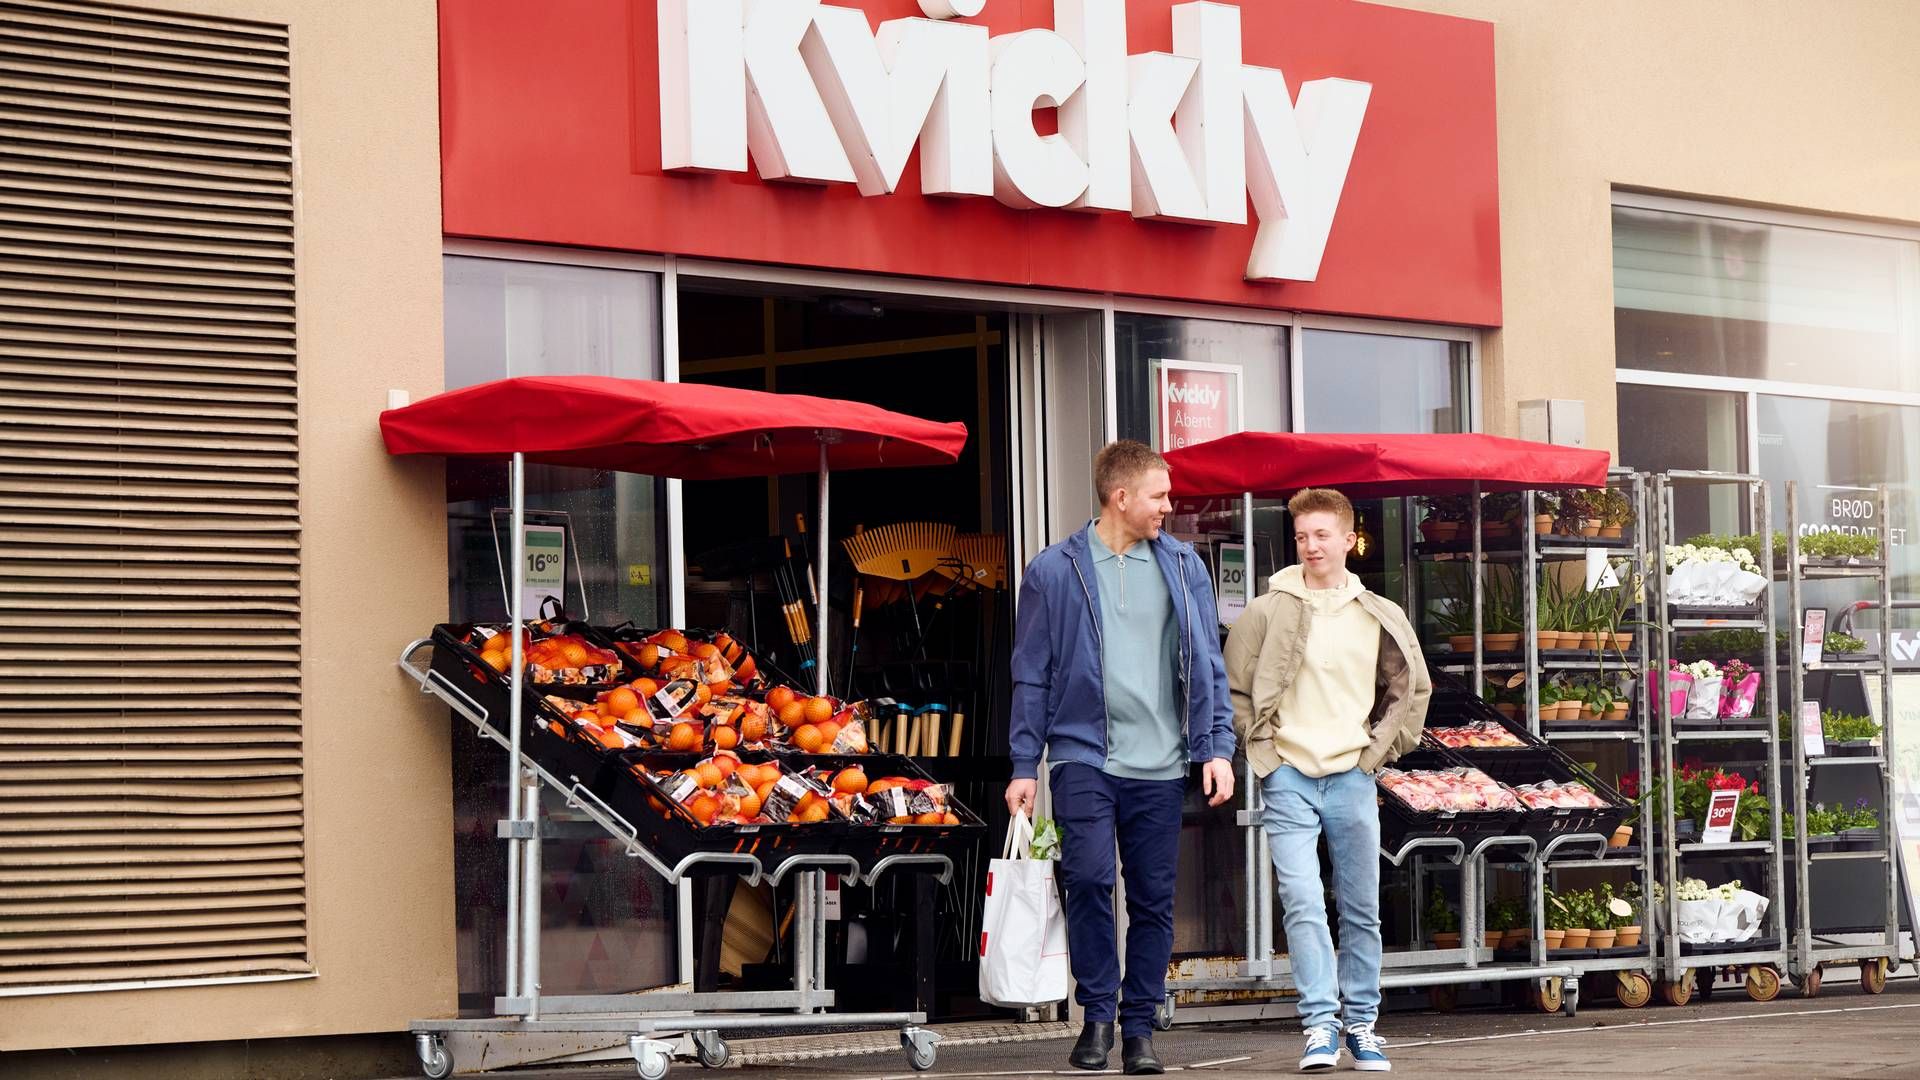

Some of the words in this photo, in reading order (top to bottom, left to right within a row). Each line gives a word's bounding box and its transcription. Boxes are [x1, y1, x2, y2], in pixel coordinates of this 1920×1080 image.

[660, 0, 1372, 281] Kvickly
[1174, 409, 1212, 429] Åbent
[1170, 433, 1184, 448] lle
[1832, 499, 1873, 518] BRØD
[1799, 523, 1906, 546] COOERATIET
